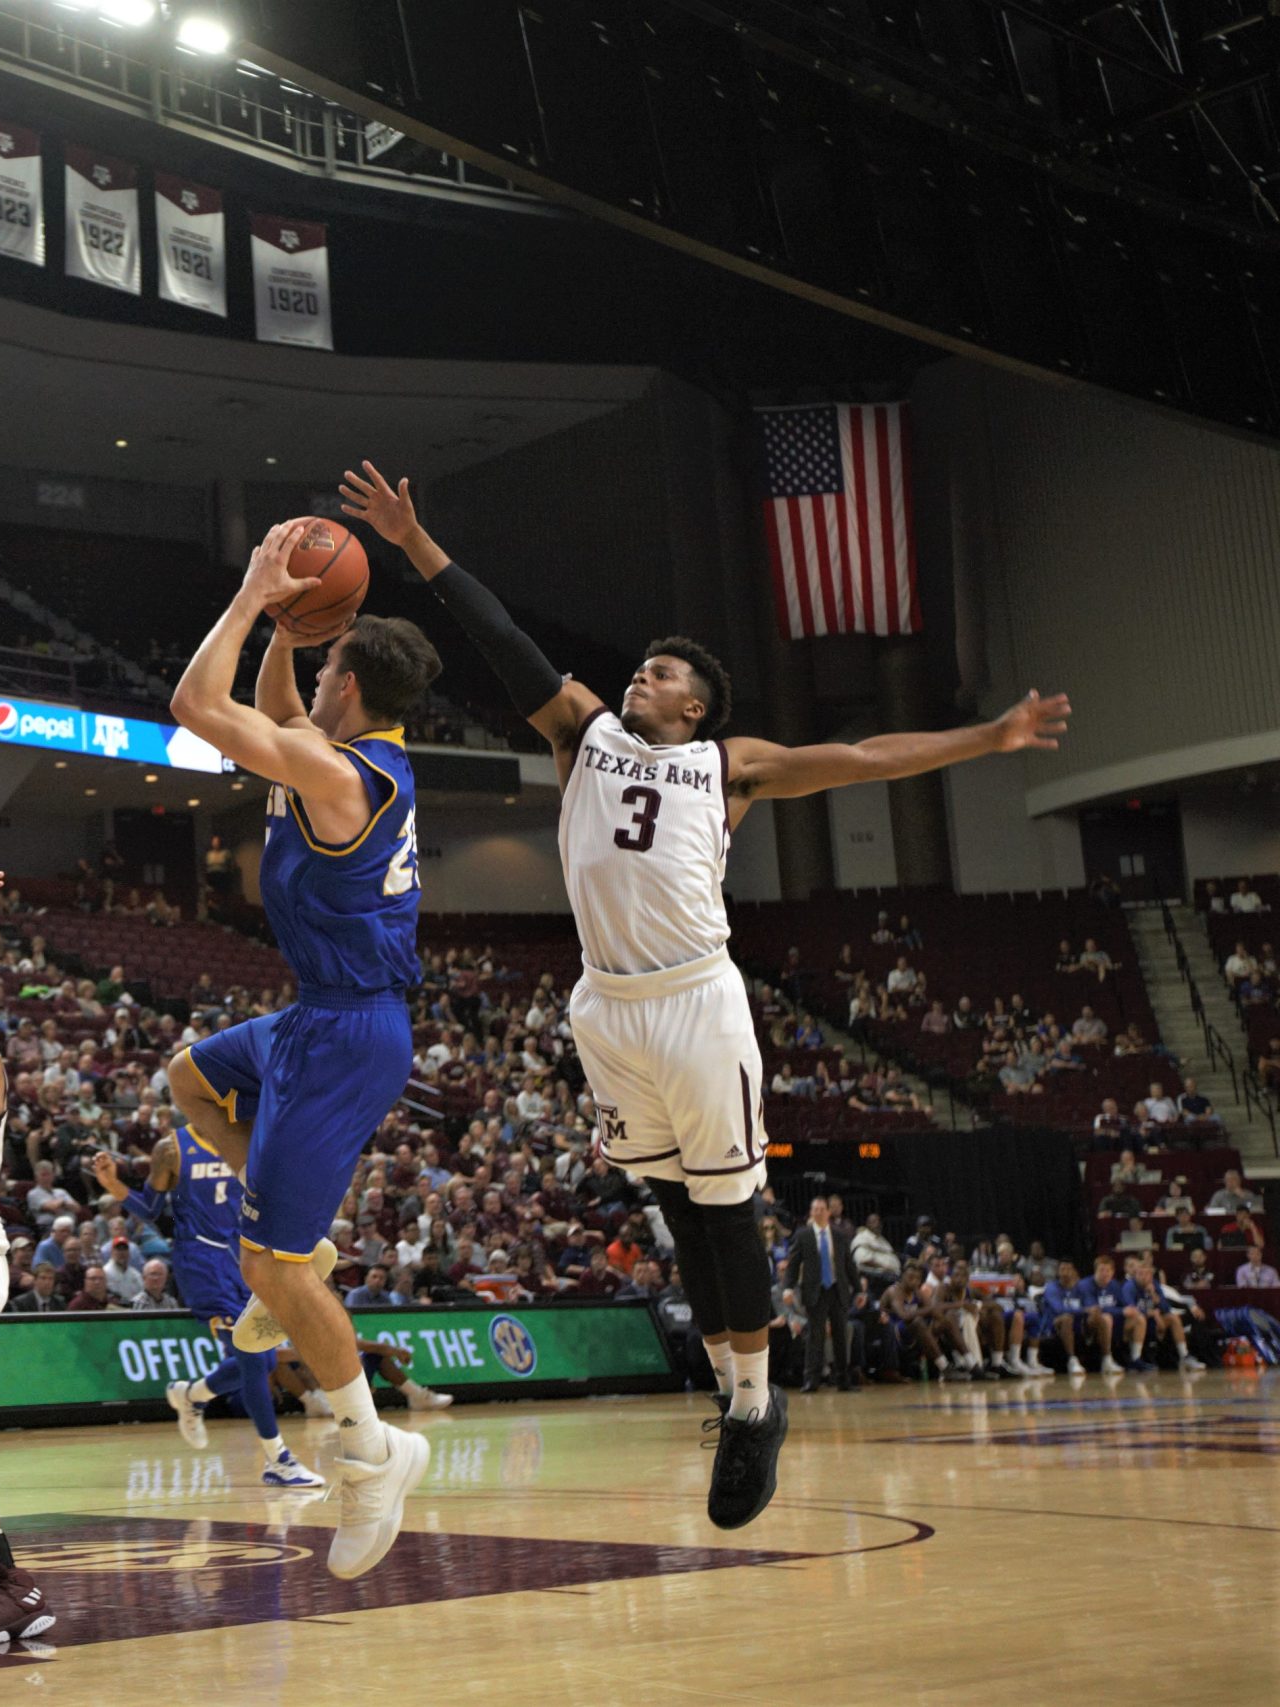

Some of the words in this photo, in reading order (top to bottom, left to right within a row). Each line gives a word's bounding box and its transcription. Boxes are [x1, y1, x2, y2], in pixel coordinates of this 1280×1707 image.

[81, 220, 124, 257] 1922
[172, 245, 213, 281] 1921
[268, 286, 319, 316] 1920
[21, 715, 75, 740] pepsi
[585, 744, 659, 781] TEXAS
[664, 762, 713, 794] A&M
[613, 785, 662, 853] 3
[191, 1162, 235, 1180] UCS
[419, 1328, 486, 1368] THE
